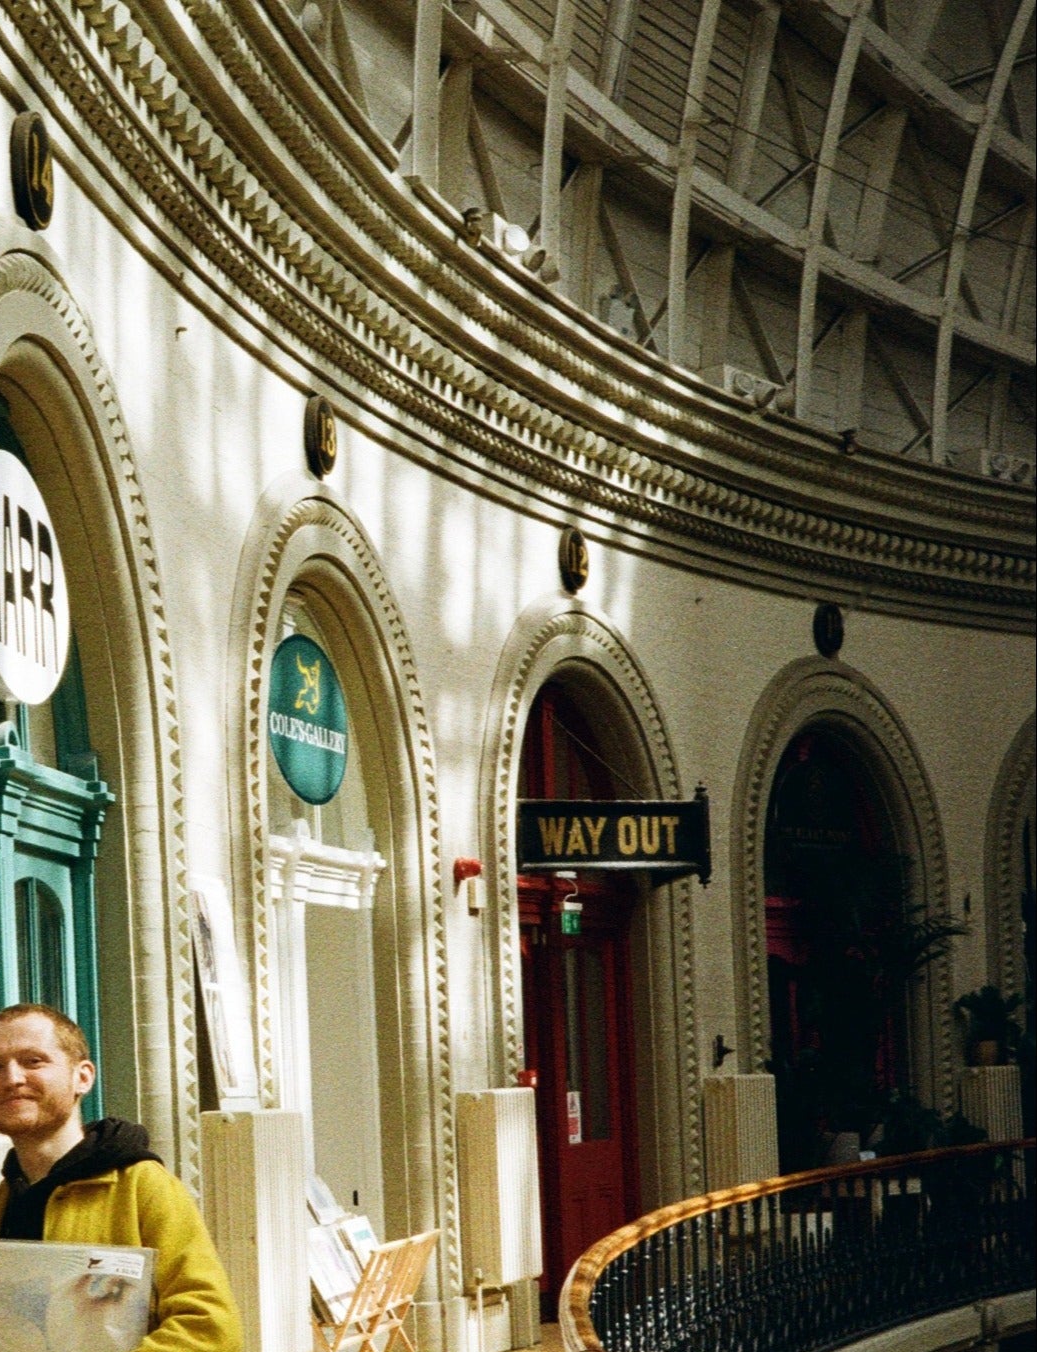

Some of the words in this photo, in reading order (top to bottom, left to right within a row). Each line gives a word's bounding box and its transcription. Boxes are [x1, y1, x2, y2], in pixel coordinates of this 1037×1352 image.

[320, 411, 336, 457] 13
[572, 542, 589, 578] 12
[537, 816, 607, 856] WAY
[617, 815, 680, 856] OUT
